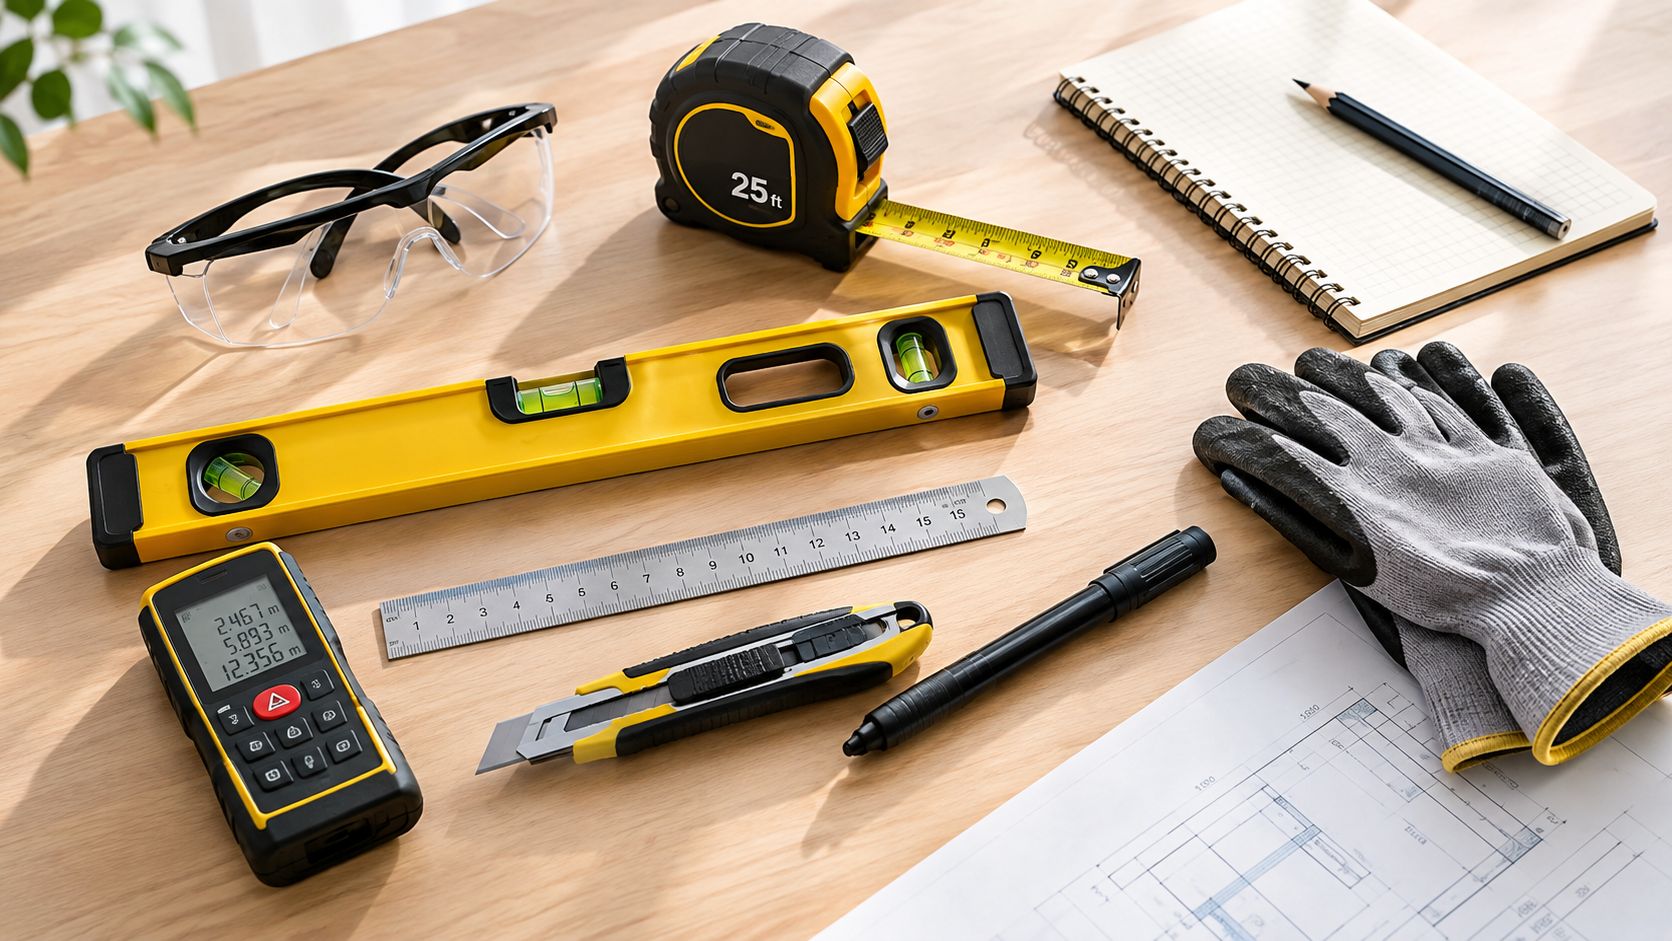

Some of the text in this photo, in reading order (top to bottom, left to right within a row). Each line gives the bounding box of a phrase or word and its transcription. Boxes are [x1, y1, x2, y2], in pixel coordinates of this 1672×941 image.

[731, 171, 784, 209] 25 ft
[446, 614, 455, 624] 2
[479, 607, 488, 617] 3
[512, 600, 521, 610] 4
[545, 593, 554, 603] 5
[578, 587, 586, 597] 5
[610, 580, 619, 591] 6
[642, 573, 651, 584] 7
[676, 567, 685, 577] 8
[708, 560, 718, 571] 9
[738, 552, 755, 564] 10
[774, 546, 788, 557] 11
[809, 538, 825, 550] 12
[845, 530, 861, 542] 13
[880, 523, 896, 534] 14
[916, 515, 932, 527] 15
[214, 603, 264, 636] 2.467
[267, 604, 280, 616] m
[223, 622, 290, 655] 5.893 m
[222, 642, 302, 681] 12.356 m
